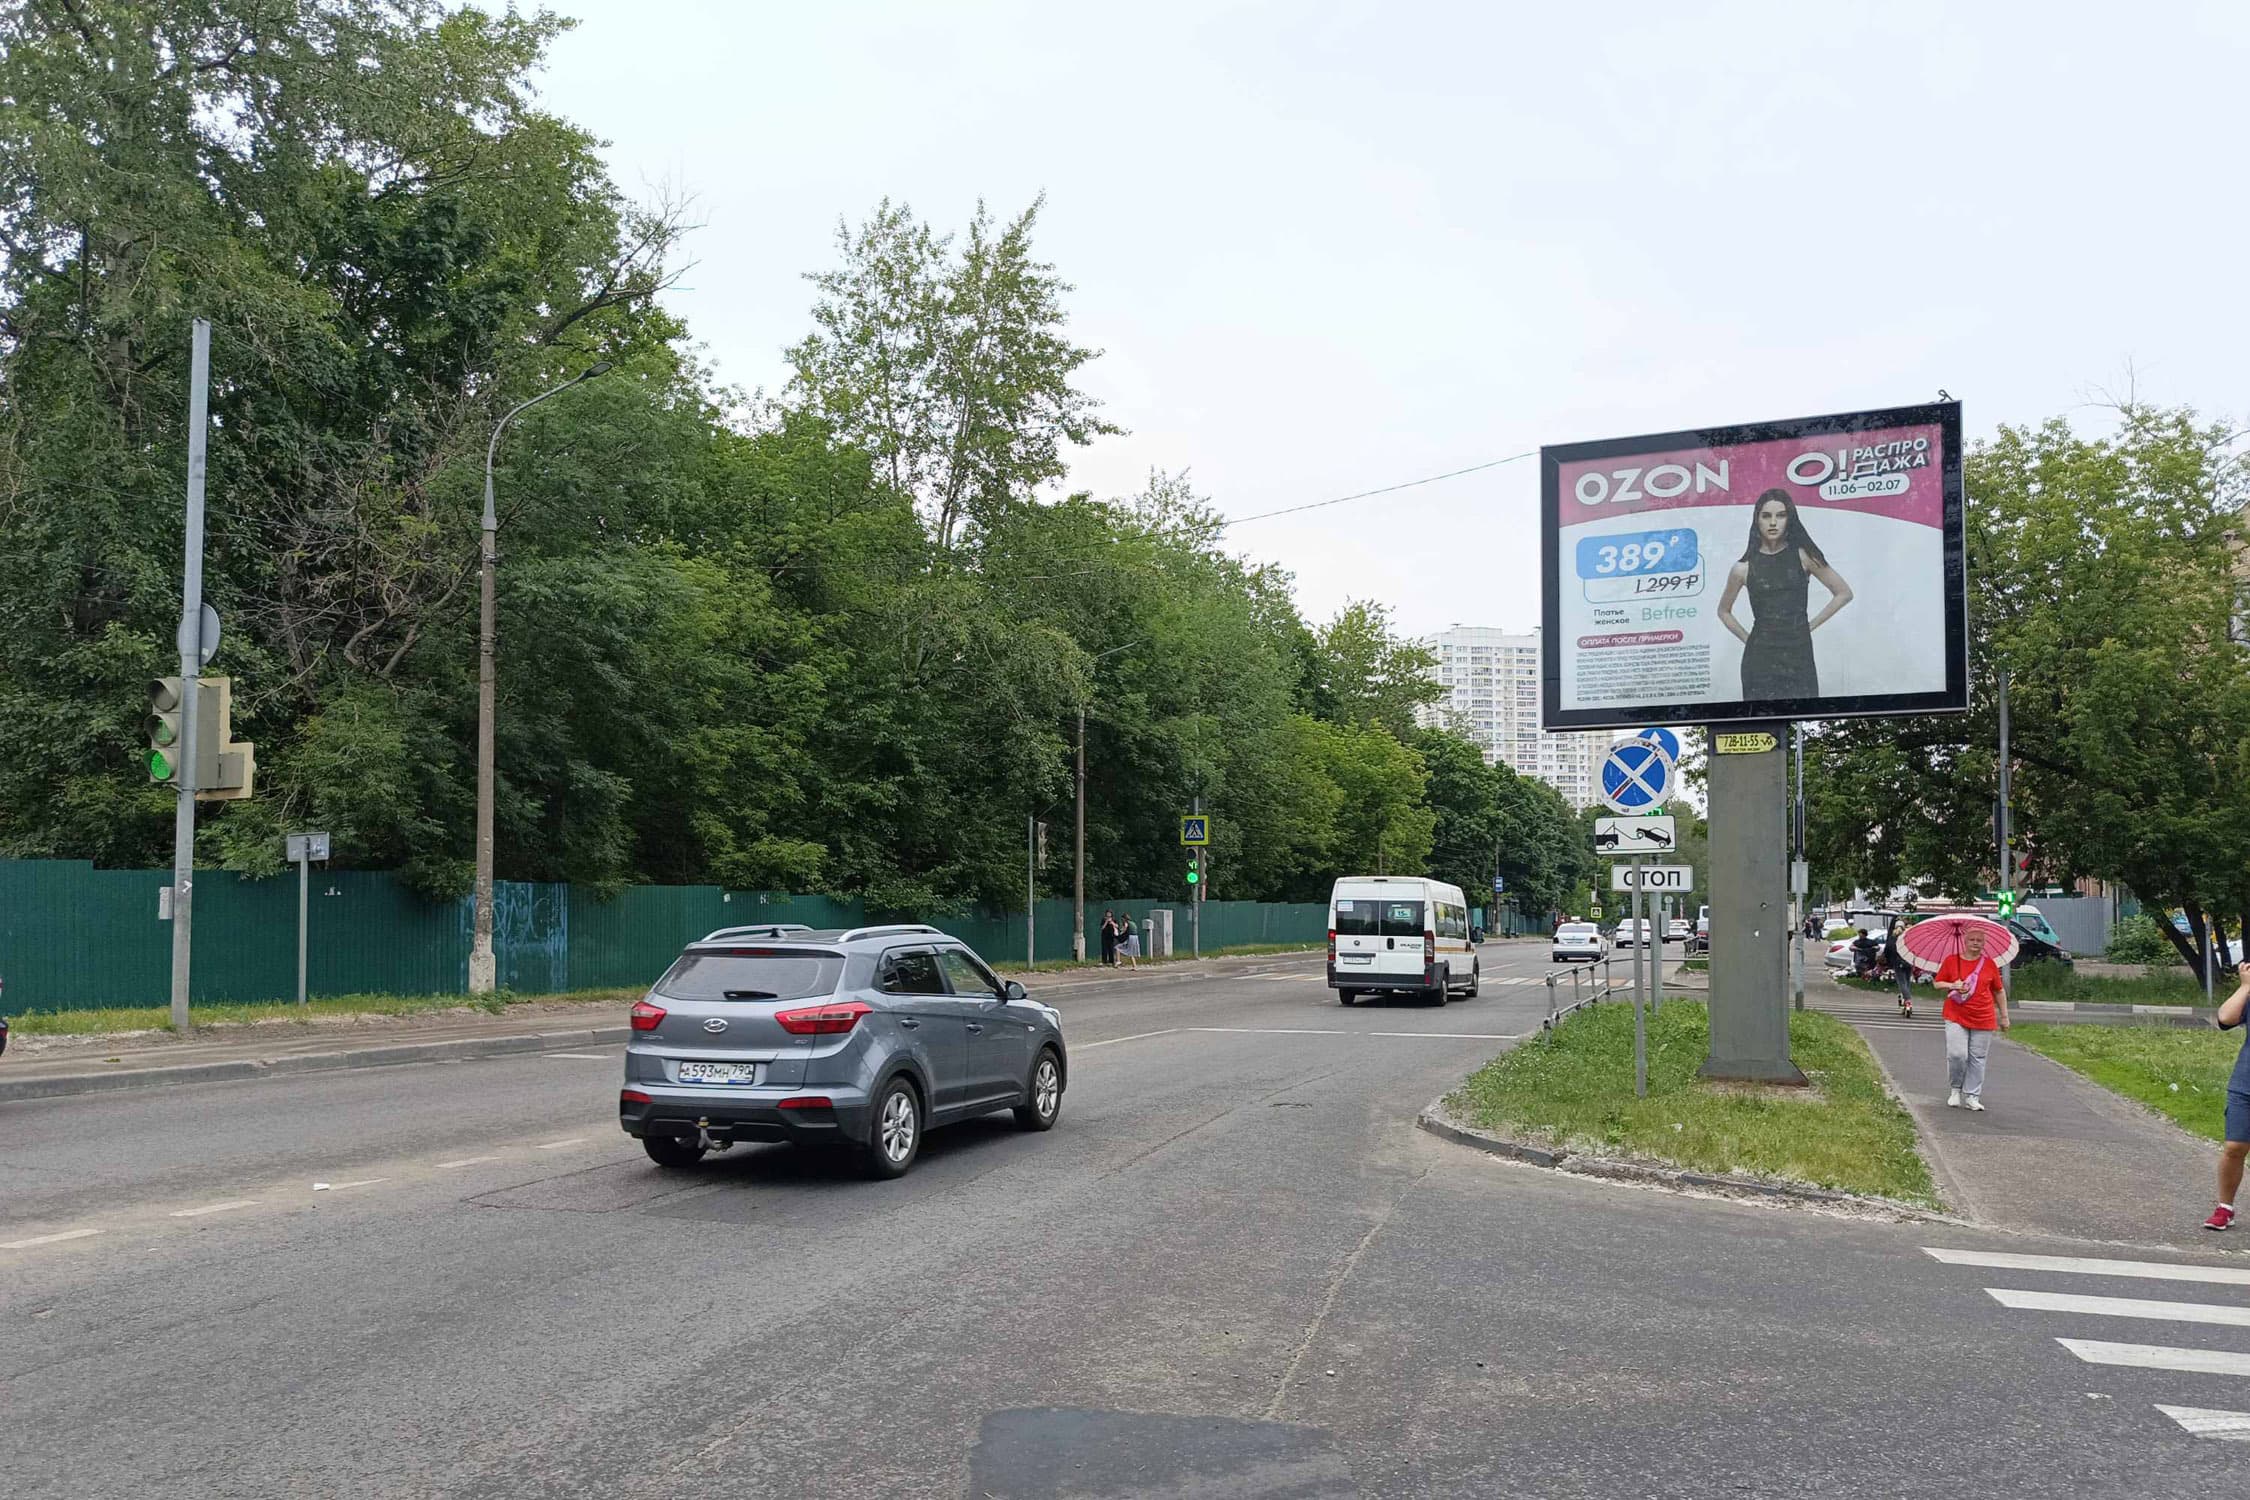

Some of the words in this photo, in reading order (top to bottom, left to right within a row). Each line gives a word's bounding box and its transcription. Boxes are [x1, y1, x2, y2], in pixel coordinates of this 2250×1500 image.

[1853, 438, 1928, 460] РАСПРО
[1850, 454, 1926, 479] ДАЖА
[1575, 459, 1729, 505] OZON
[1594, 609, 1624, 617] Платье
[1641, 606, 1697, 621] Befree
[1580, 637, 1610, 646] ОПЛАТА
[1611, 635, 1638, 644] ПОСЛЕ
[1638, 633, 1679, 643] ПРИМЕРКИ
[1623, 871, 1681, 886] СТОП
